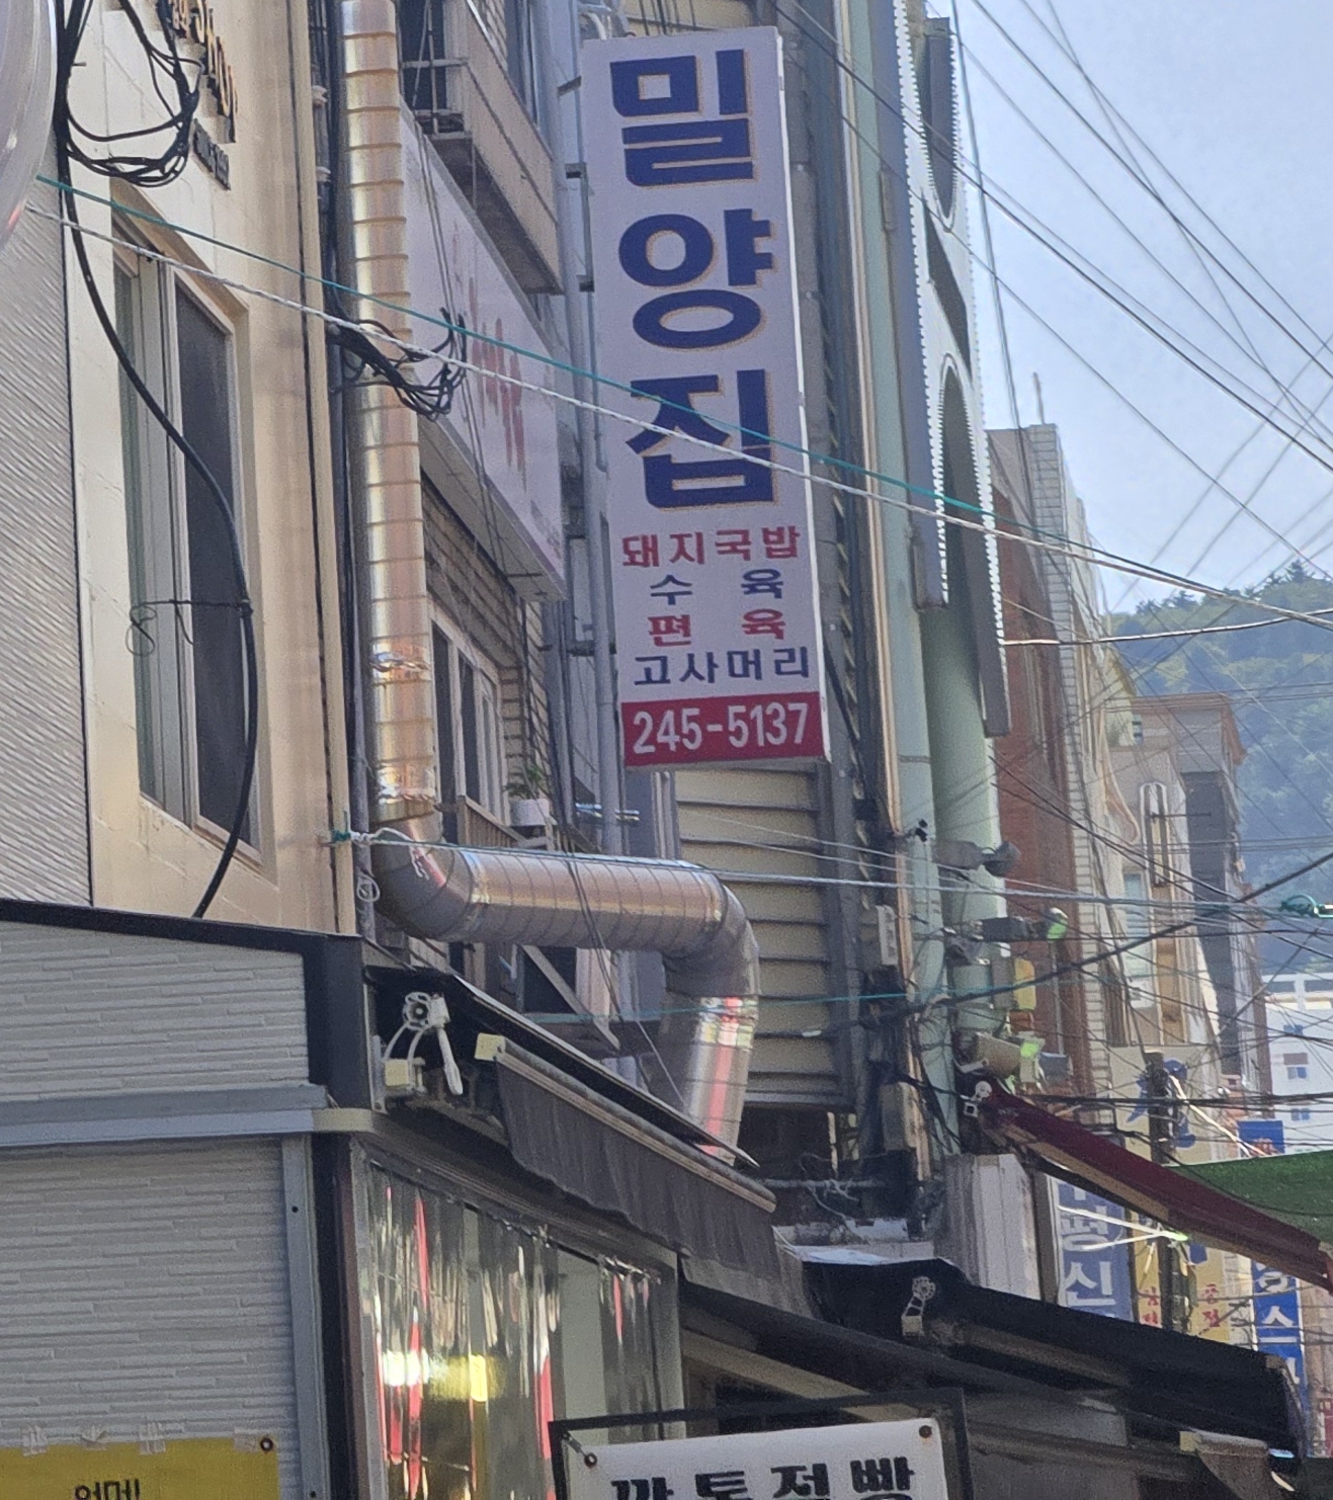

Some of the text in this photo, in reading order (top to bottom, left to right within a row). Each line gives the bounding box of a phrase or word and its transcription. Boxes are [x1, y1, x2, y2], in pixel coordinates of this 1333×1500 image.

[609, 47, 776, 509] 밀양집
[621, 525, 801, 568] 돼지국밥
[633, 646, 810, 686] 고사머리
[632, 701, 809, 755] 245-5137
